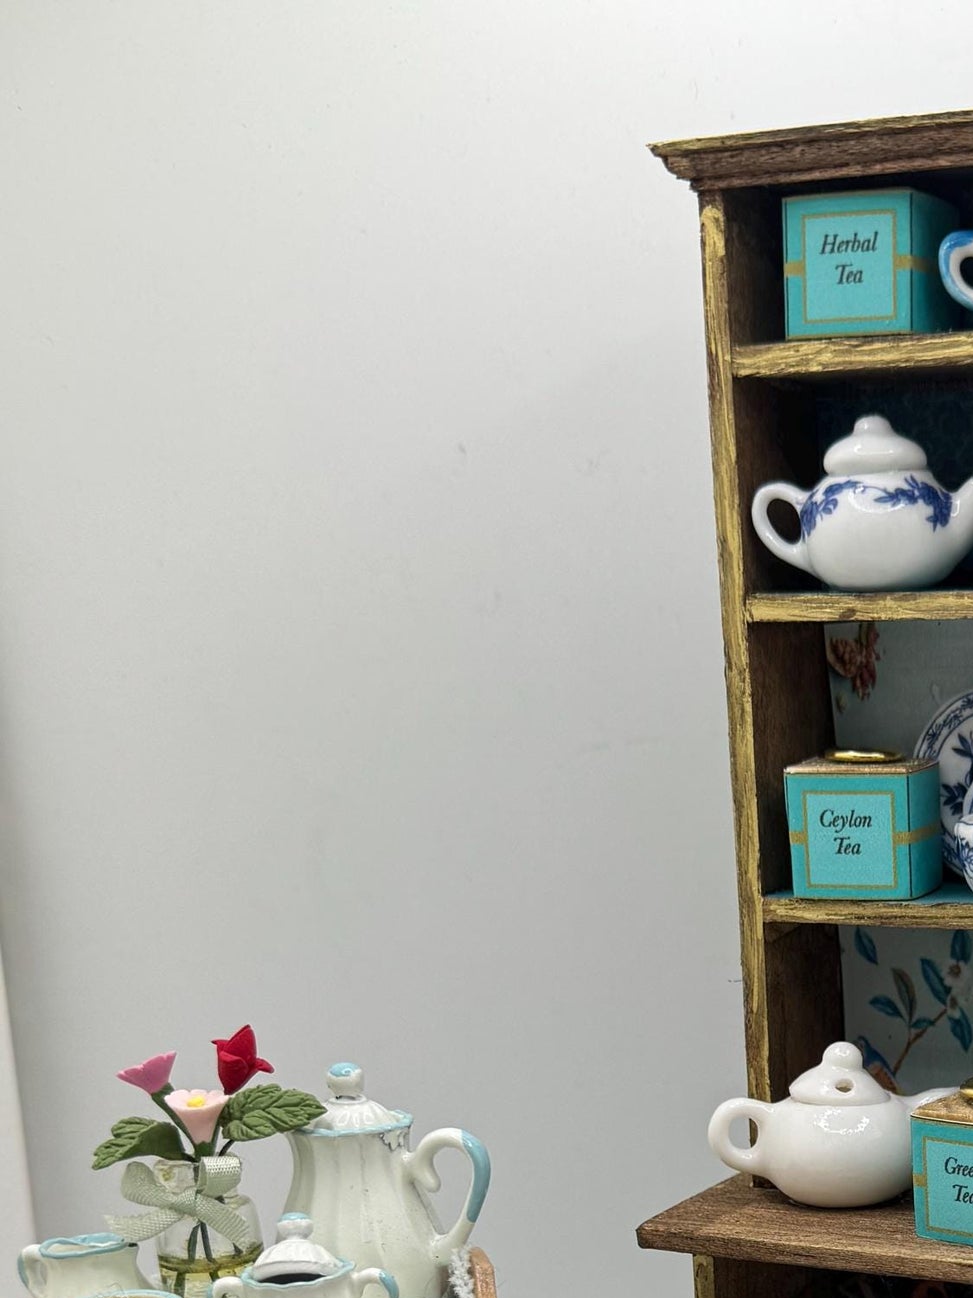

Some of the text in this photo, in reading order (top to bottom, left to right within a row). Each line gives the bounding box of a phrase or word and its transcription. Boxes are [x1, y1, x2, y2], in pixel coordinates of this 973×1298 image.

[820, 230, 878, 255] Herbal
[835, 263, 863, 285] Tea
[819, 809, 872, 833] Ceylon
[833, 837, 862, 855] Tea
